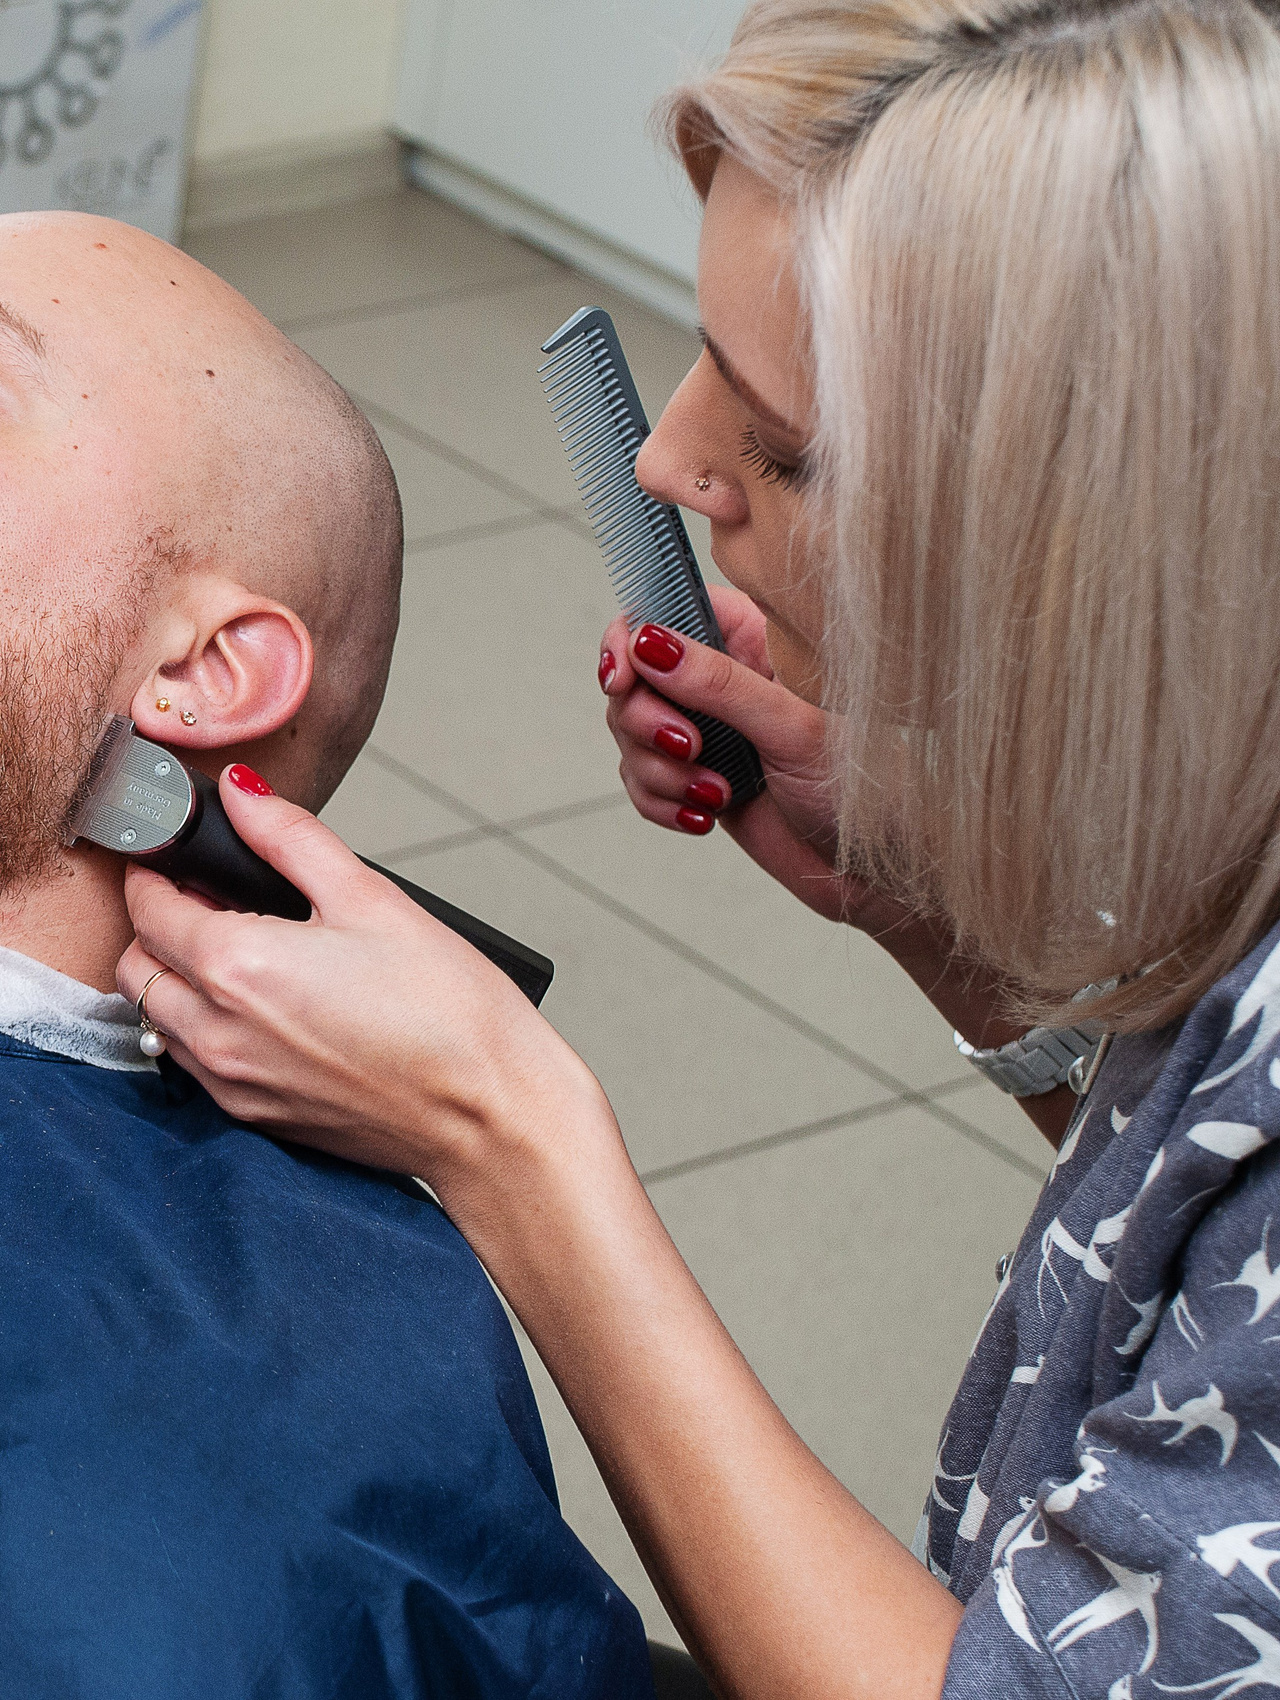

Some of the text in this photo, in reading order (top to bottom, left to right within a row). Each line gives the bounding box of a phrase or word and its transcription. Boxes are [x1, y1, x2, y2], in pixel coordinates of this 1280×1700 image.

[127, 782, 171, 808] Germany
[123, 797, 162, 820] Made in
